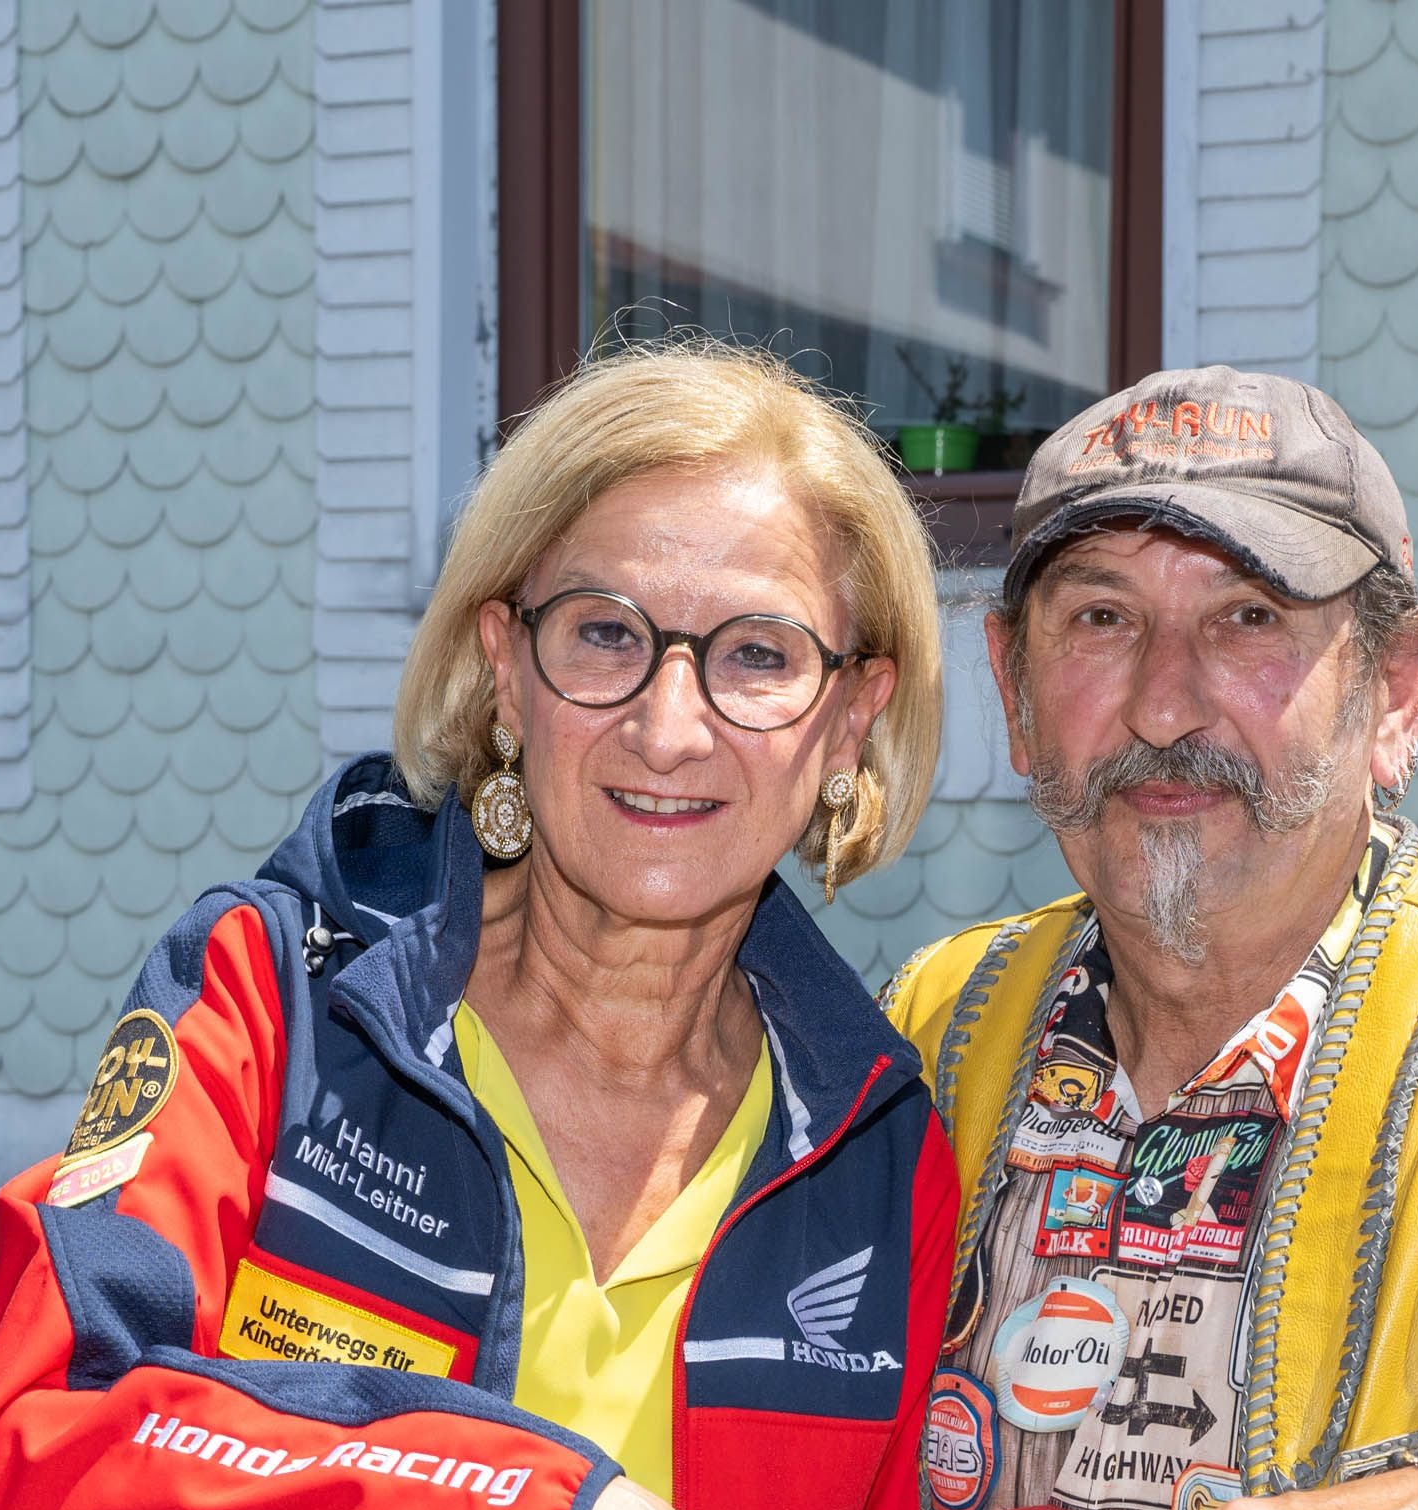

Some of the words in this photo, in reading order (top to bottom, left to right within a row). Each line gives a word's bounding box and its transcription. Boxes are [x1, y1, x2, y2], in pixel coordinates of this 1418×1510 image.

[1082, 401, 1273, 455] TOY-RUN
[295, 1135, 450, 1239] Mikl-Leitner
[335, 1118, 427, 1196] Hanni
[260, 1295, 379, 1361] Unterwegs
[382, 1345, 415, 1373] für
[791, 1340, 903, 1373] HONDA
[1076, 1336, 1111, 1366] Oil
[320, 1440, 534, 1507] Racing
[1074, 1446, 1192, 1486] HIGHWAY
